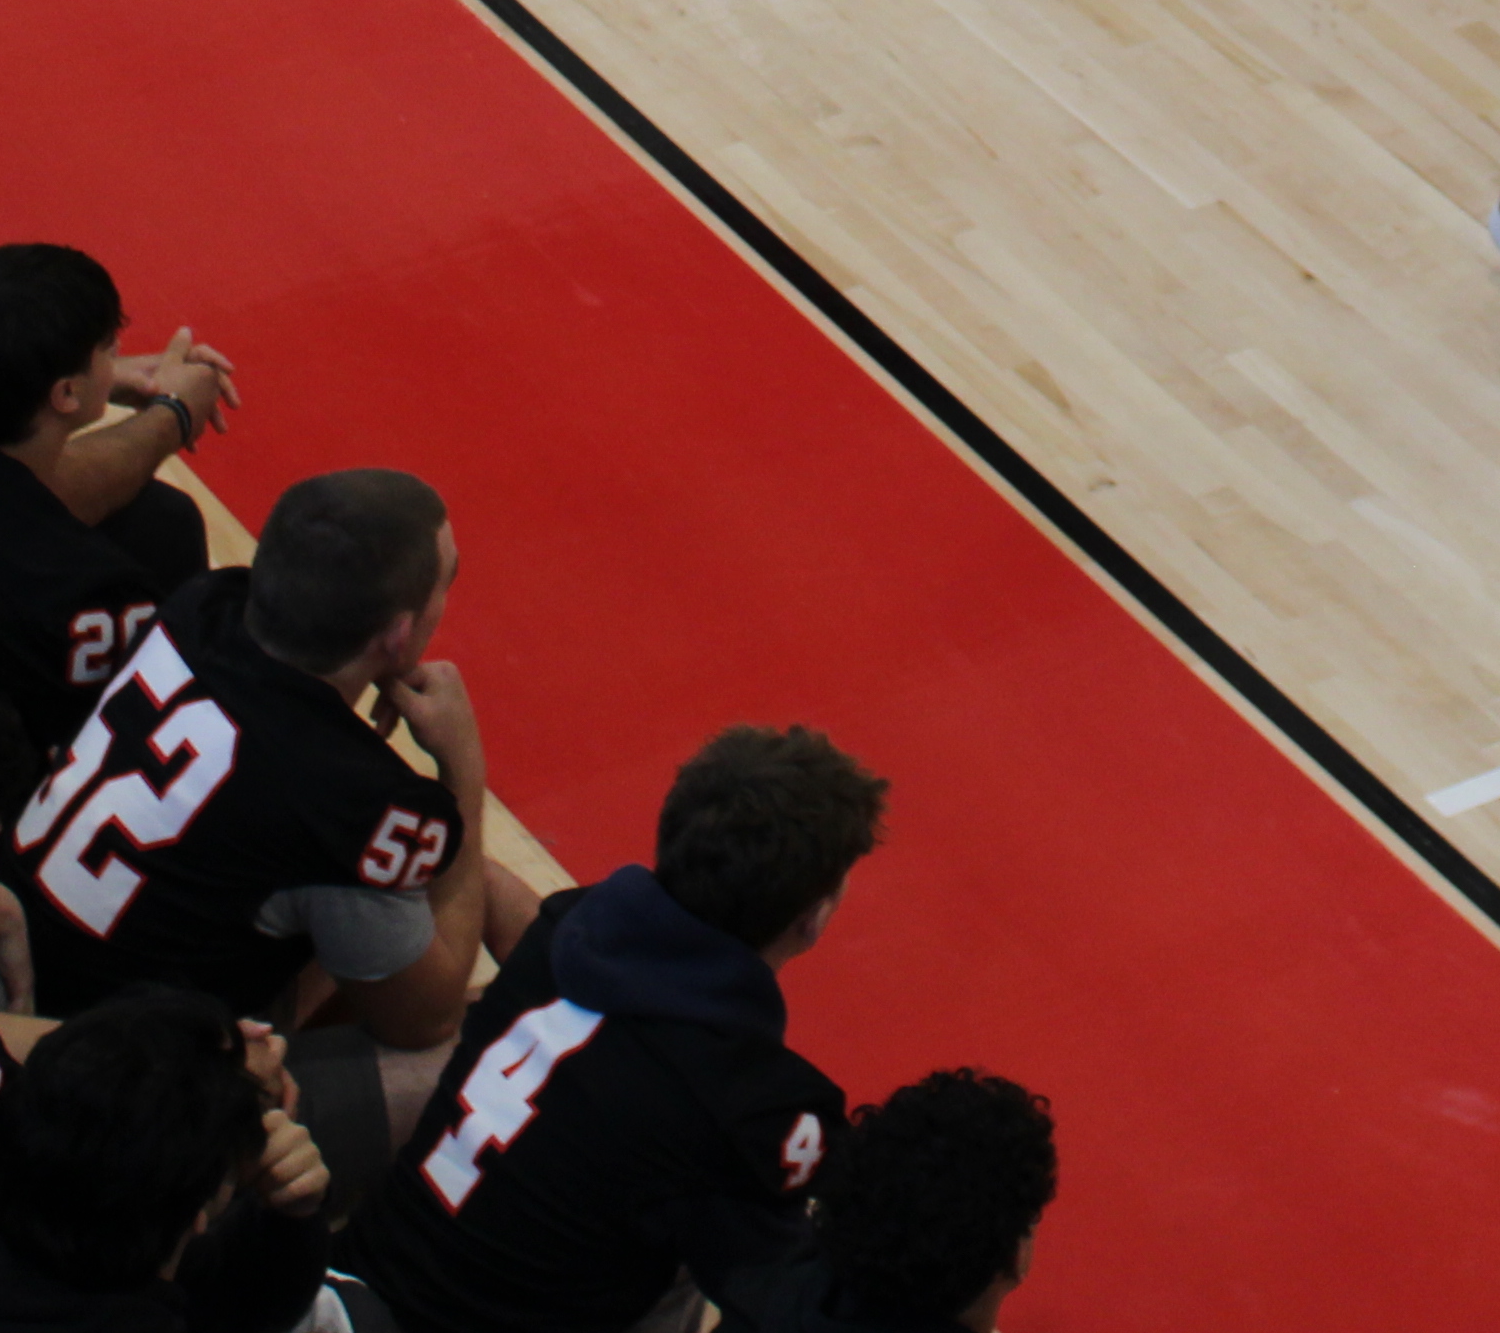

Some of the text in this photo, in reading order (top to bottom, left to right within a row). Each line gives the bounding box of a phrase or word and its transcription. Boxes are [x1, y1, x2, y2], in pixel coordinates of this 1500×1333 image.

[13, 621, 242, 941] 52
[357, 804, 450, 891] 52
[419, 996, 607, 1218] 4
[780, 1112, 827, 1191] 4
